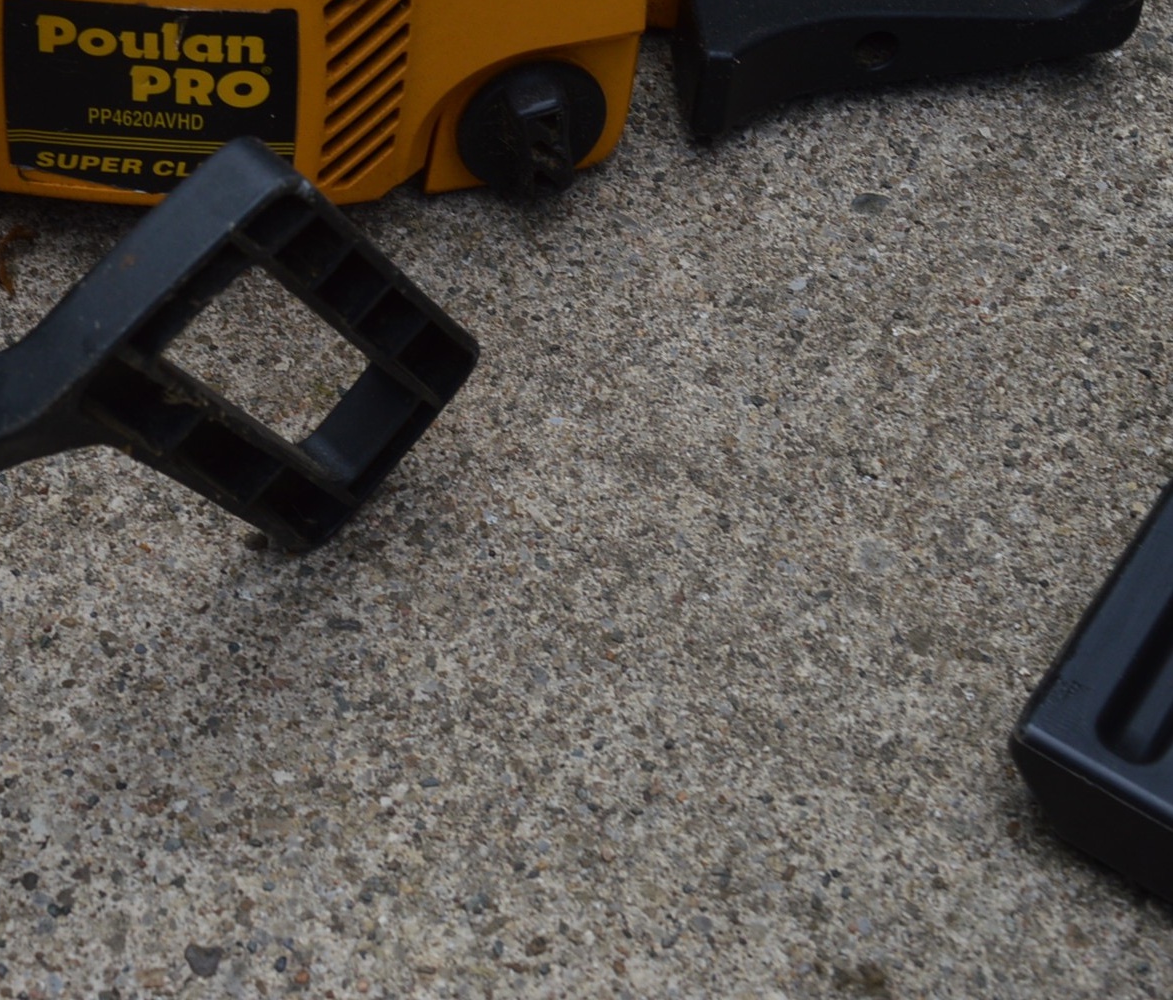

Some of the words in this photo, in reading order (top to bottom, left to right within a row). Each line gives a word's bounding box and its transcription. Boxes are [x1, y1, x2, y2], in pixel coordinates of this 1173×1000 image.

[36, 14, 266, 64] Poulan
[130, 65, 270, 108] PRO
[88, 107, 204, 131] PP4620AVHD
[36, 151, 143, 176] SUPER
[152, 160, 201, 177] CL
